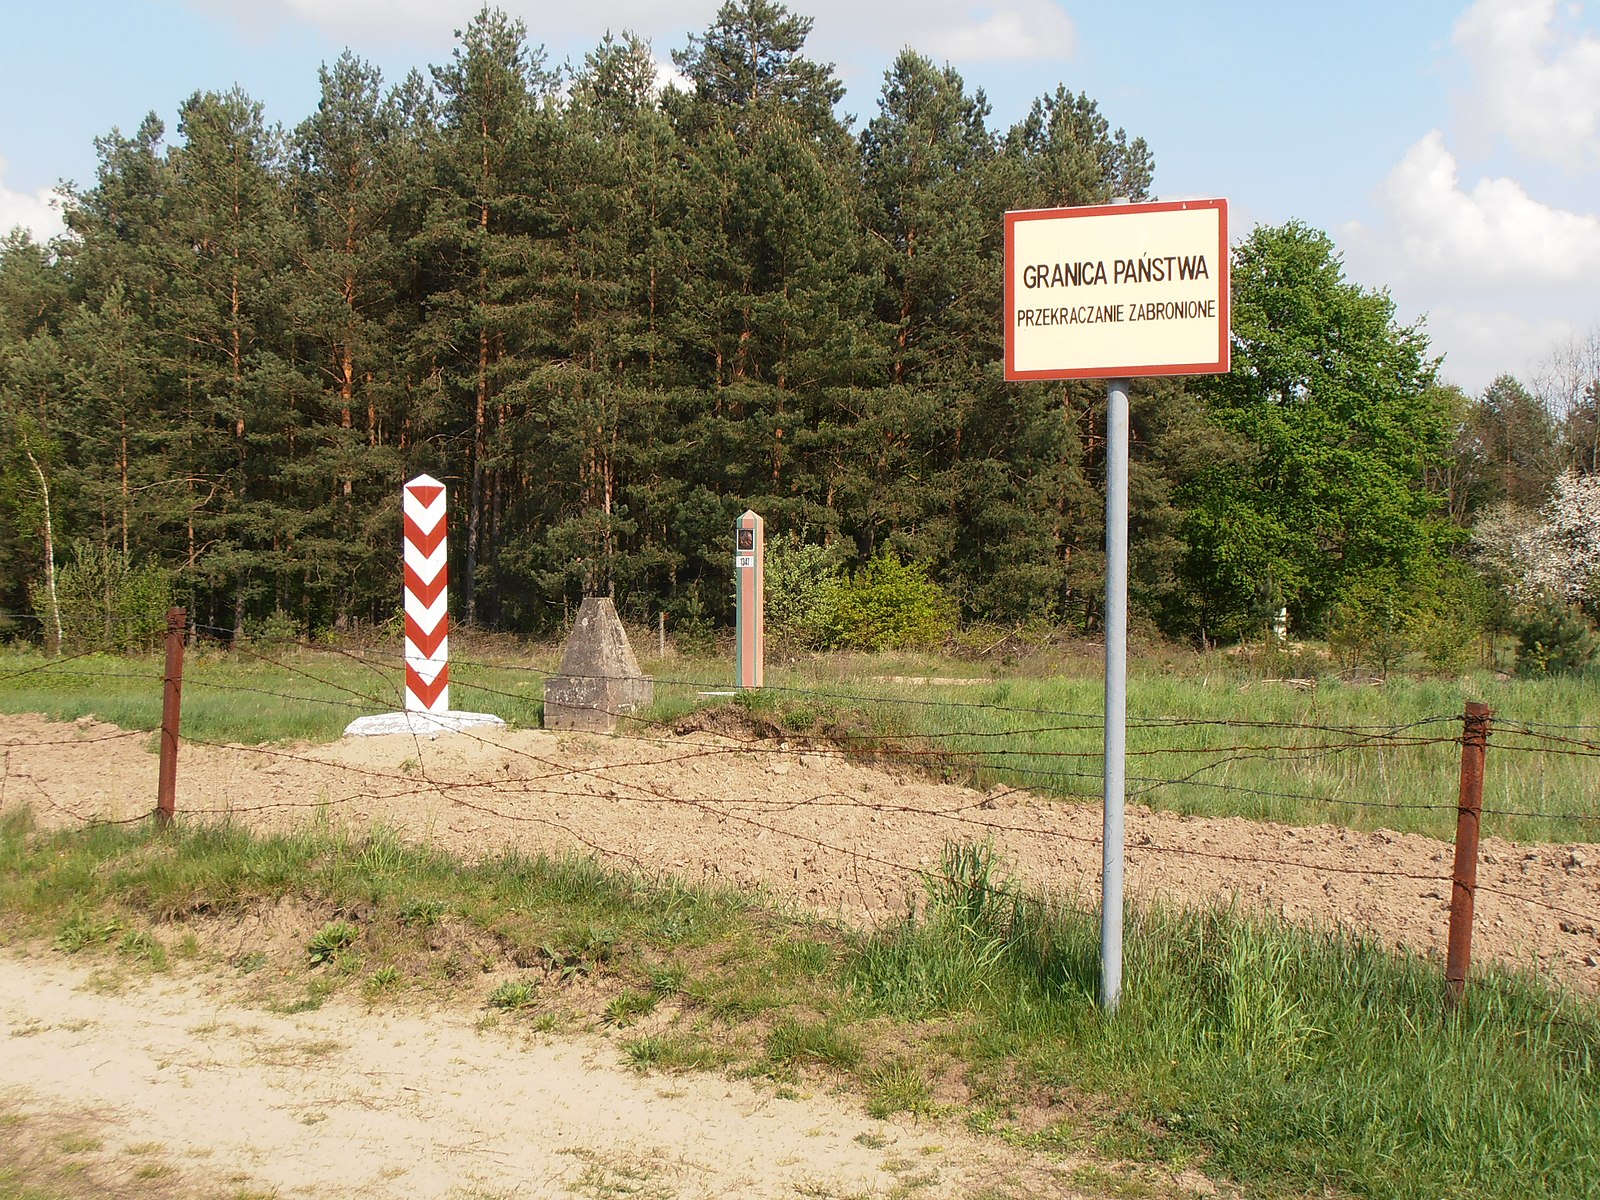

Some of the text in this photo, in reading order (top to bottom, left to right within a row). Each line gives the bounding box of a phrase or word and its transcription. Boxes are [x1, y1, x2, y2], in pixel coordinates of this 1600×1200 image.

[1023, 252, 1209, 289] GRANICA PAŃSTWA
[1017, 300, 1216, 327] PRZEKRACZANIE ZABRONIONE
